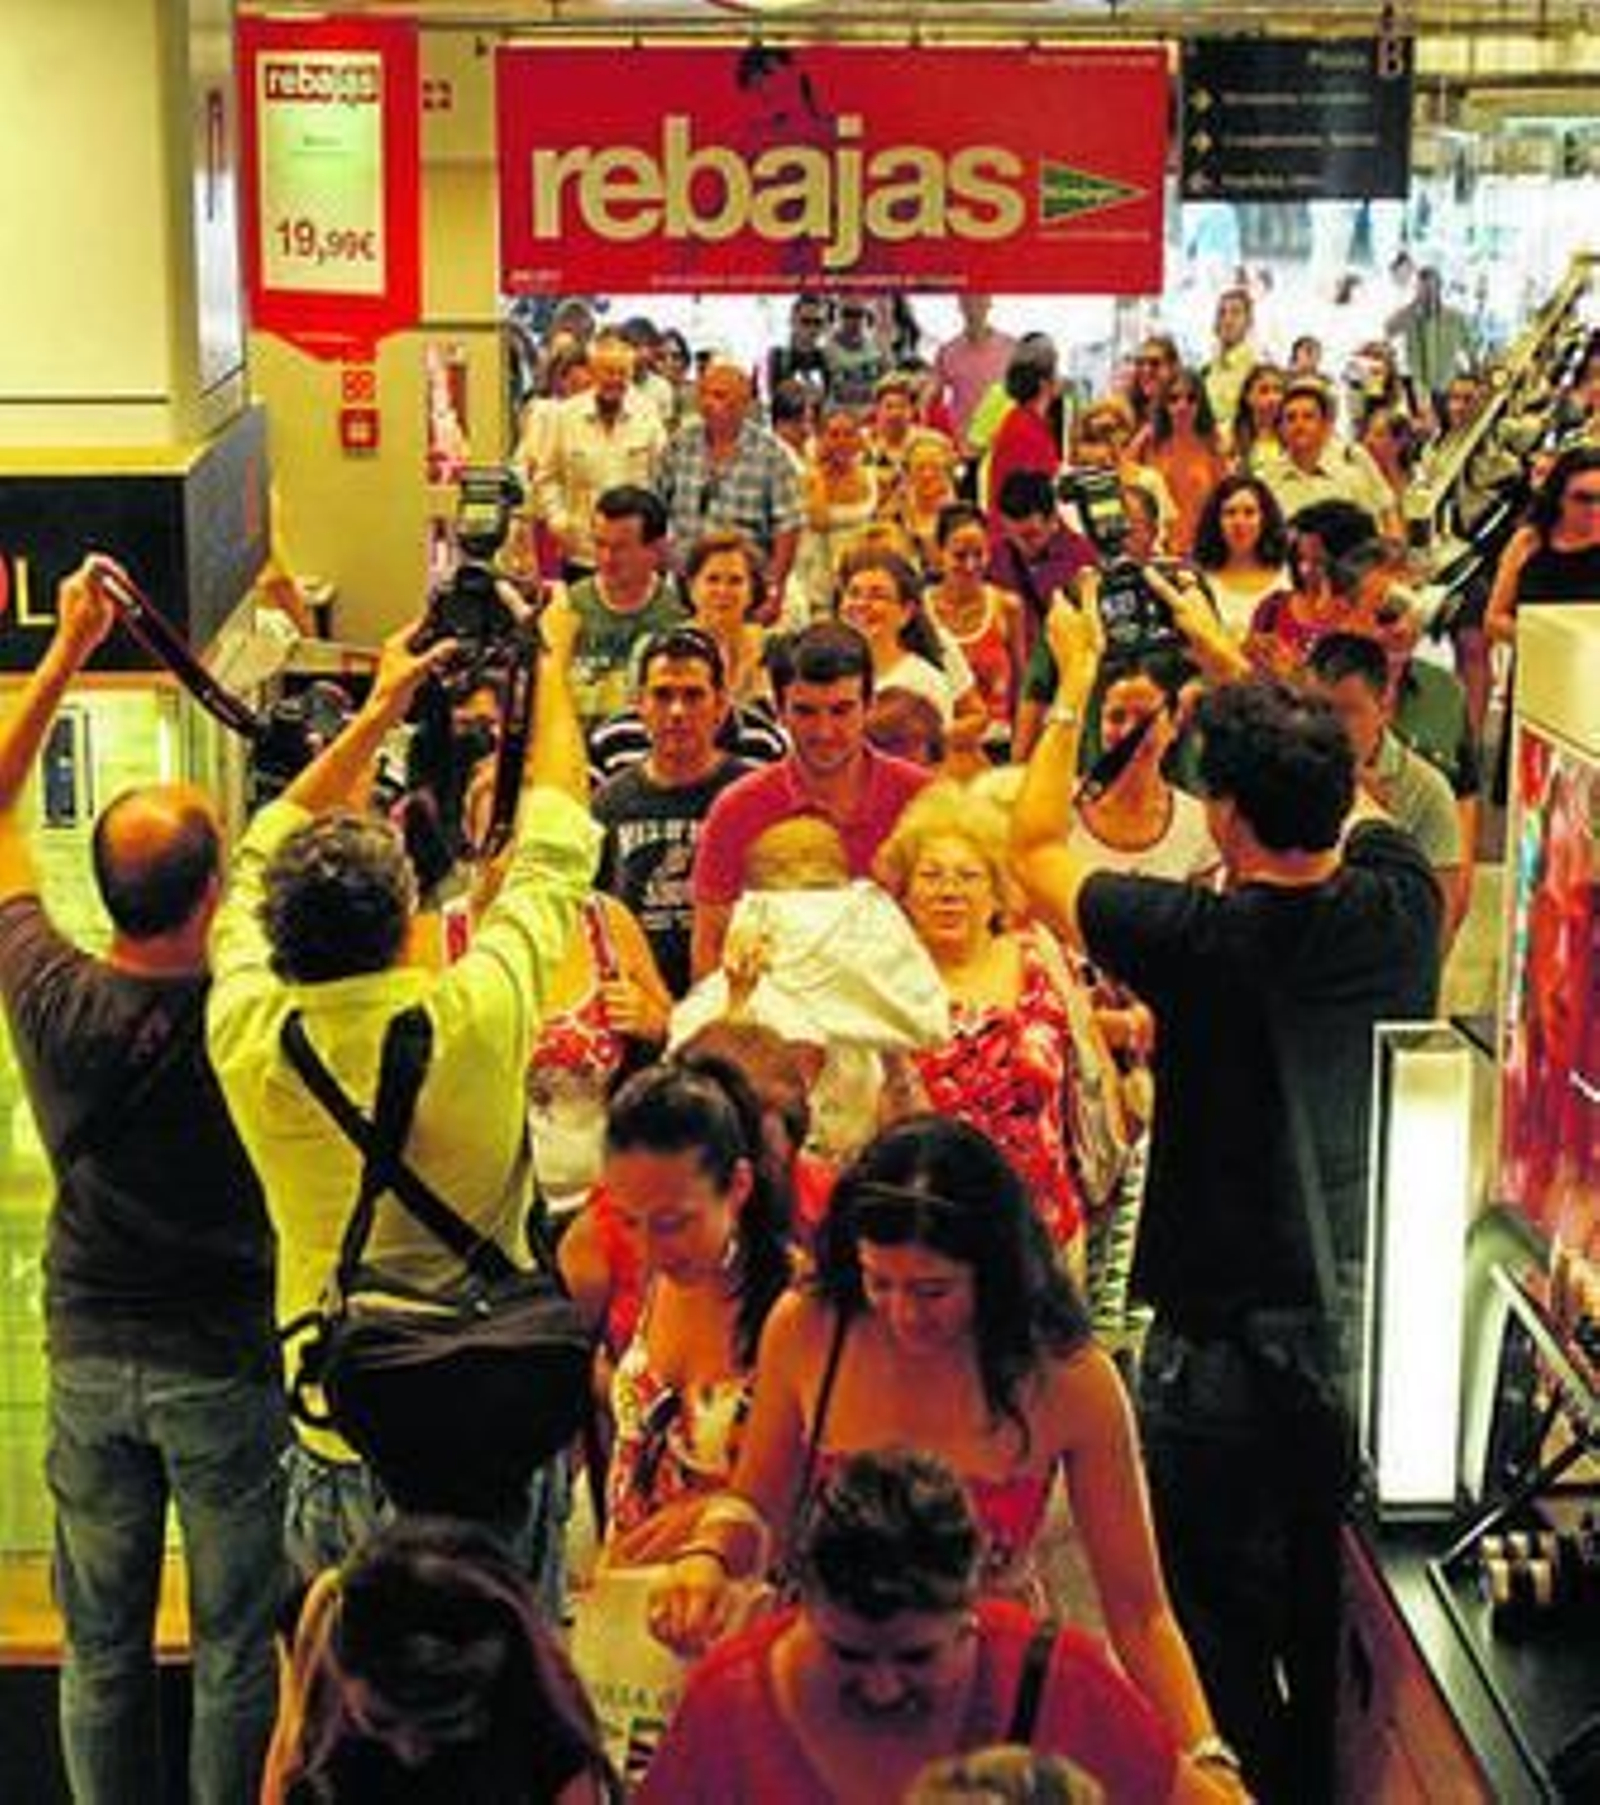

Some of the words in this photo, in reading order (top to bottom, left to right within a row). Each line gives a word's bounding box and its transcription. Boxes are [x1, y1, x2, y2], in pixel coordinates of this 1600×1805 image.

[1378, 40, 1402, 78] B
[267, 65, 379, 107] rebajas
[531, 114, 1026, 268] rebajas
[275, 217, 376, 265] 19,99€
